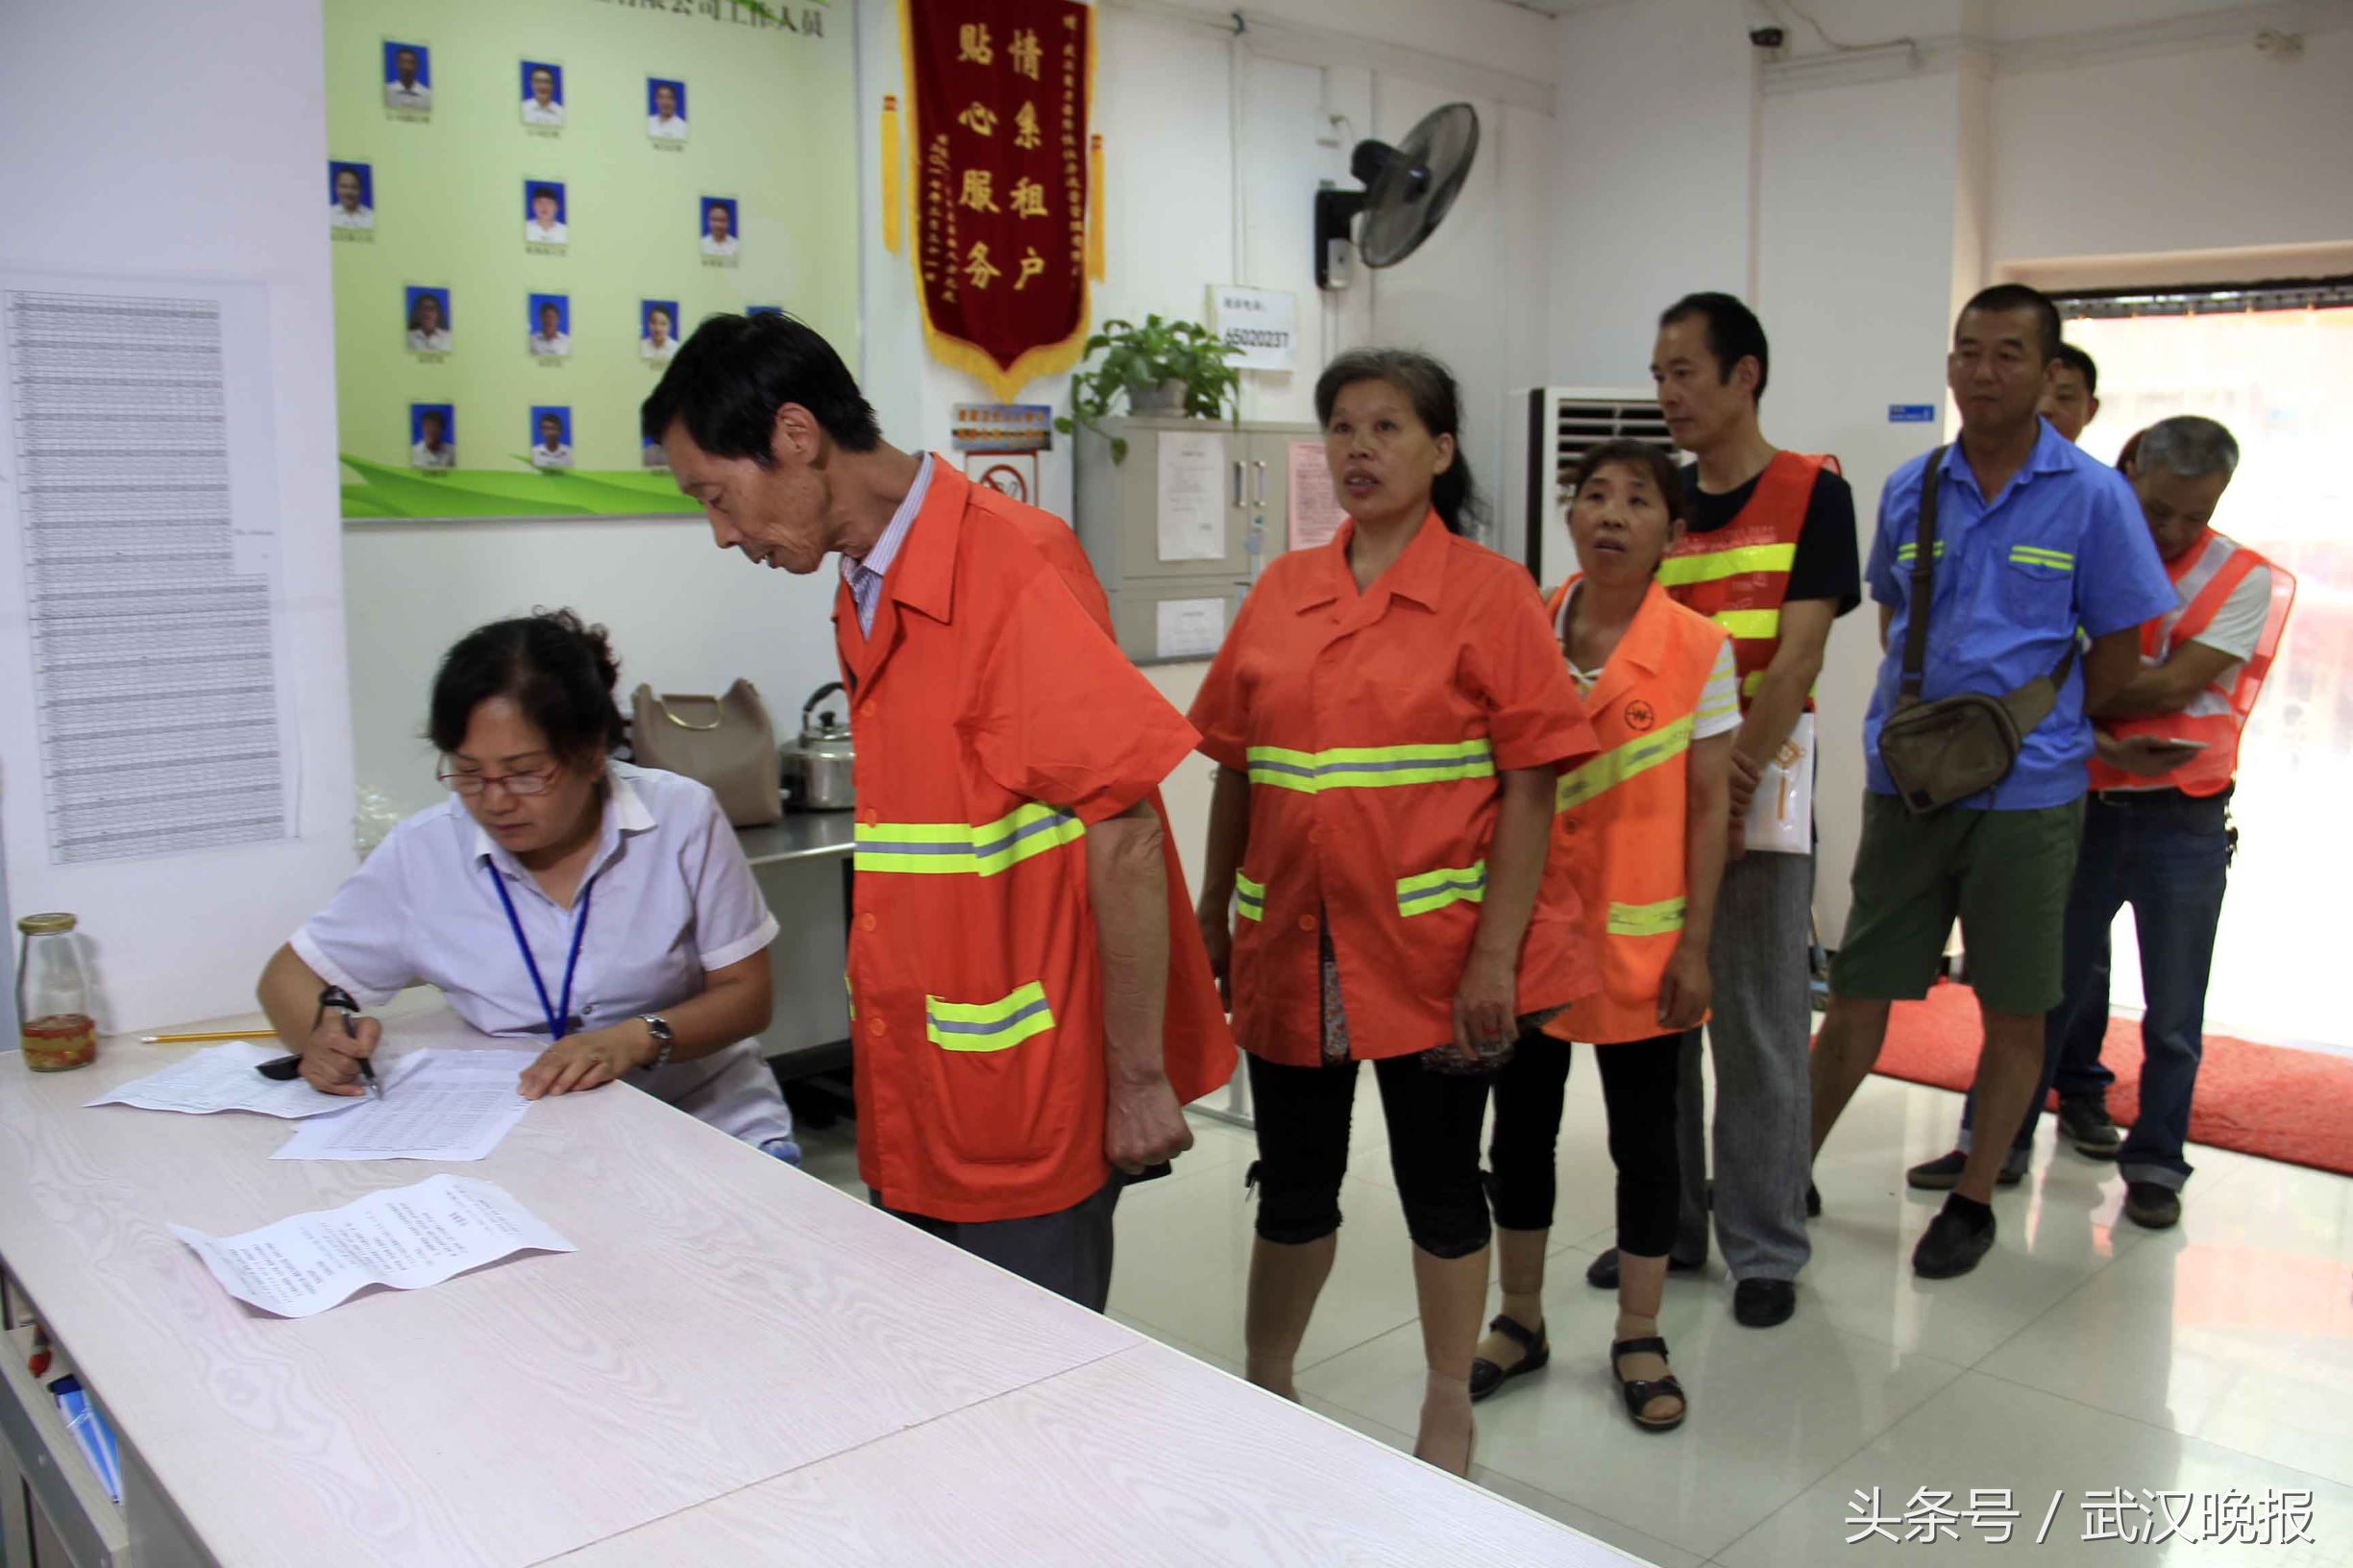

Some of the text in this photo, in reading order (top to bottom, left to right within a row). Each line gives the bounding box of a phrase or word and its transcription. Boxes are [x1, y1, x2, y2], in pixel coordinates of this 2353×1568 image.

[618, 0, 823, 37] 公司工作人员
[958, 24, 1001, 289] 贴心服务
[1009, 30, 1048, 290] 情系租户
